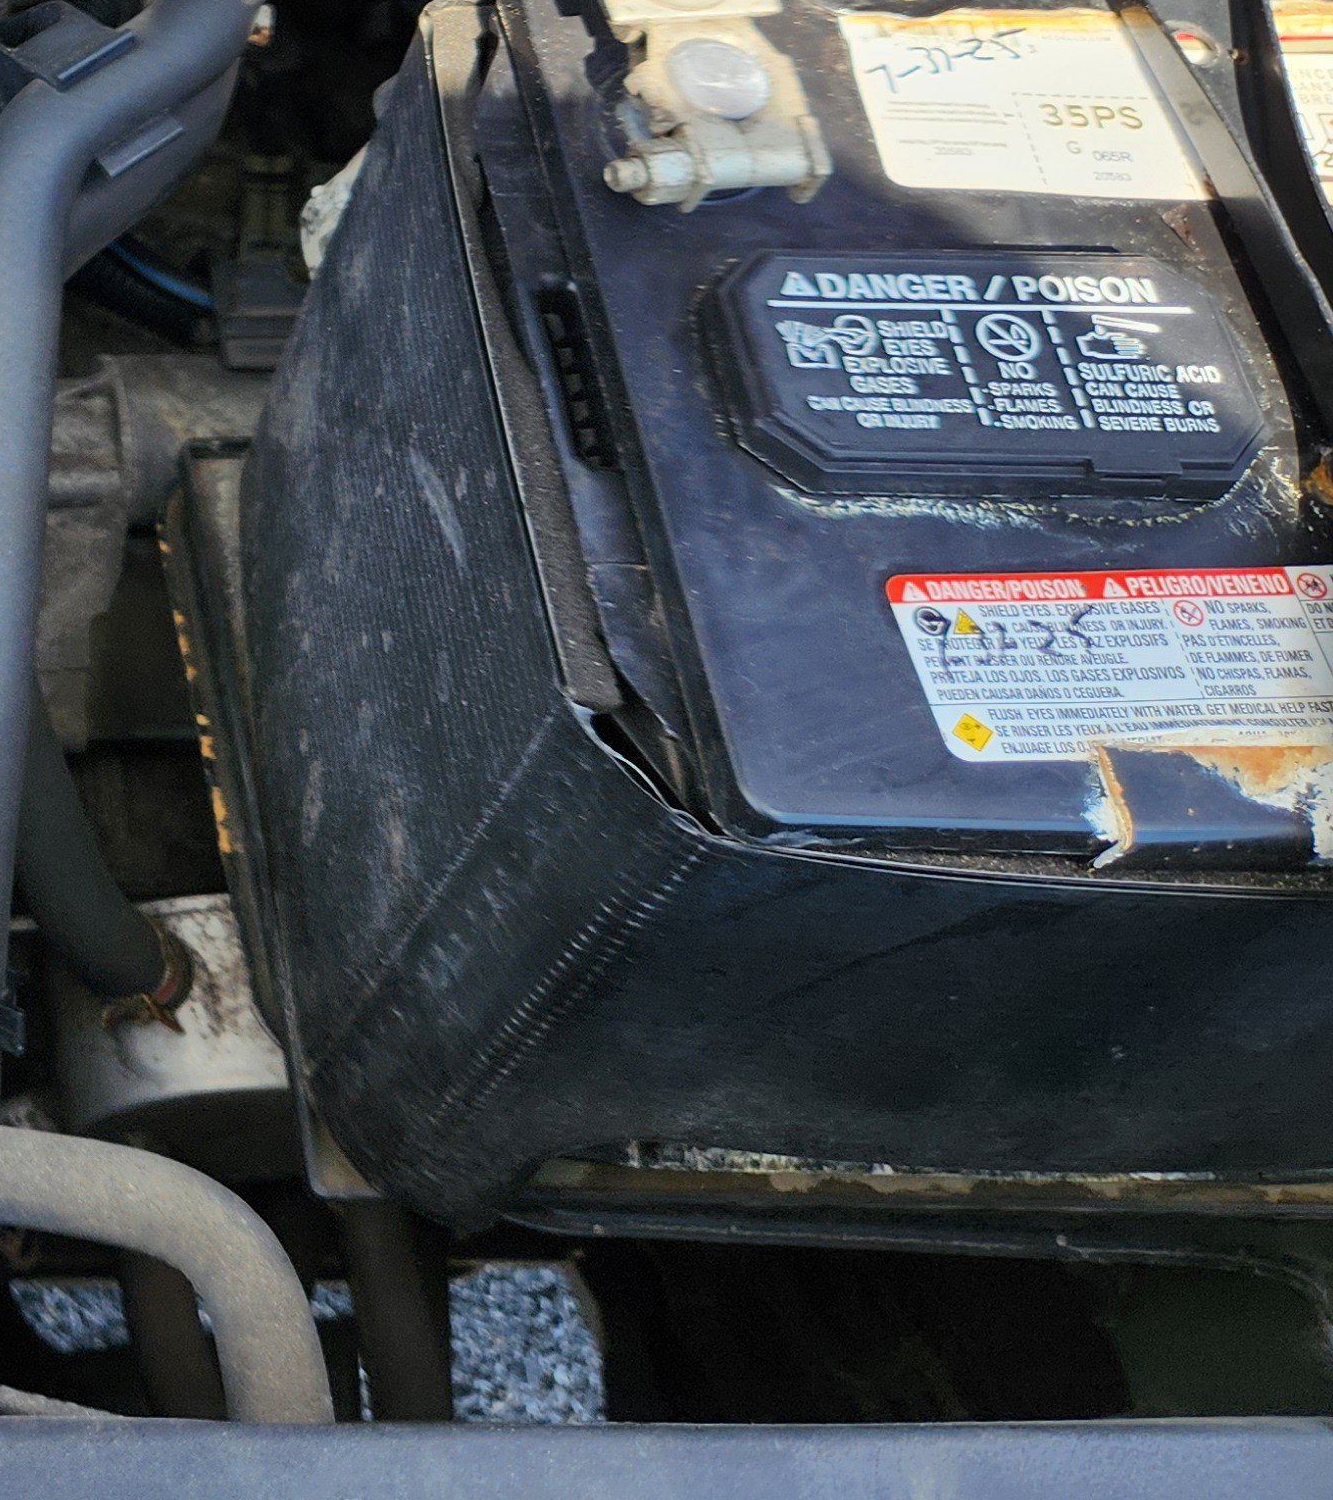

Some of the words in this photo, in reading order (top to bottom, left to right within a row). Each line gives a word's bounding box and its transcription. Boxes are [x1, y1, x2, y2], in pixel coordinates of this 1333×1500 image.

[1039, 103, 1144, 130] 35PS
[1065, 140, 1083, 155] G
[814, 273, 981, 301] DANGER
[1011, 275, 1160, 304] POISON
[876, 320, 949, 339] SHIELD
[883, 339, 941, 357] EYES
[842, 356, 954, 376] EXPLOSIVE
[997, 362, 1036, 380] NO
[1077, 361, 1173, 383] SULFURIC
[1175, 365, 1223, 385] ACID
[850, 376, 920, 395] GASES
[1085, 382, 1122, 398] CAN
[1124, 383, 1181, 399] CAUSE
[841, 396, 891, 412] CAUSE
[891, 397, 976, 414] BLINDNESS
[1091, 398, 1185, 415] BLINDNESS
[1187, 401, 1215, 417] OR
[856, 412, 882, 429] OR
[882, 413, 942, 430] INJURY
[1097, 415, 1163, 432] SEVERE
[1164, 417, 1222, 434] BURNS
[925, 579, 1085, 601] DANGER/POISON
[1125, 573, 1290, 597] PELIGRO/VENENO
[979, 604, 1019, 617] SHIELD
[1121, 601, 1161, 615] GASES
[1203, 601, 1225, 615] NO
[1226, 602, 1272, 615] SPARKS,
[1306, 602, 1323, 614] DO
[1111, 619, 1126, 631] OR
[1208, 619, 1256, 632] FLAMES,
[1257, 617, 1308, 630] SMOKING
[918, 638, 935, 651] SE
[1106, 633, 1169, 648] EXPLOSIFS
[1183, 635, 1208, 648] PAS
[1021, 653, 1037, 667] OU
[1190, 651, 1206, 664] DE
[1206, 650, 1260, 664] FLAMMES,
[1260, 649, 1275, 663] DE
[1275, 649, 1313, 662] FUMER
[984, 670, 1007, 684] LOS
[1046, 669, 1069, 682] LOS
[1071, 668, 1111, 682] GASES
[1113, 665, 1186, 681] EXPLOSIVOS
[1197, 667, 1216, 680] NO
[1217, 667, 1266, 680] CHISPAS,
[1265, 666, 1313, 680] FLAMAS,
[938, 688, 980, 702] PUEDEN
[982, 687, 1023, 701] CAUSAR
[1024, 685, 1063, 700] DAÑOS
[1204, 684, 1258, 697] CIGARROS
[988, 707, 1023, 721] FLUSH
[1027, 707, 1055, 720] EYES
[1056, 705, 1129, 720] IMMEDIATELY
[1132, 705, 1161, 718] WITH
[1206, 703, 1228, 716] GET
[1229, 702, 1278, 716] MEDICAL
[1279, 702, 1307, 714] HELP
[995, 726, 1010, 738] SE
[1012, 725, 1053, 738] RINSER
[1053, 725, 1074, 737] LES
[1074, 723, 1105, 736] YEUX
[1117, 720, 1149, 733] L'EAU
[1001, 741, 1053, 754] ENJUAGE
[1055, 740, 1074, 753] LOS
